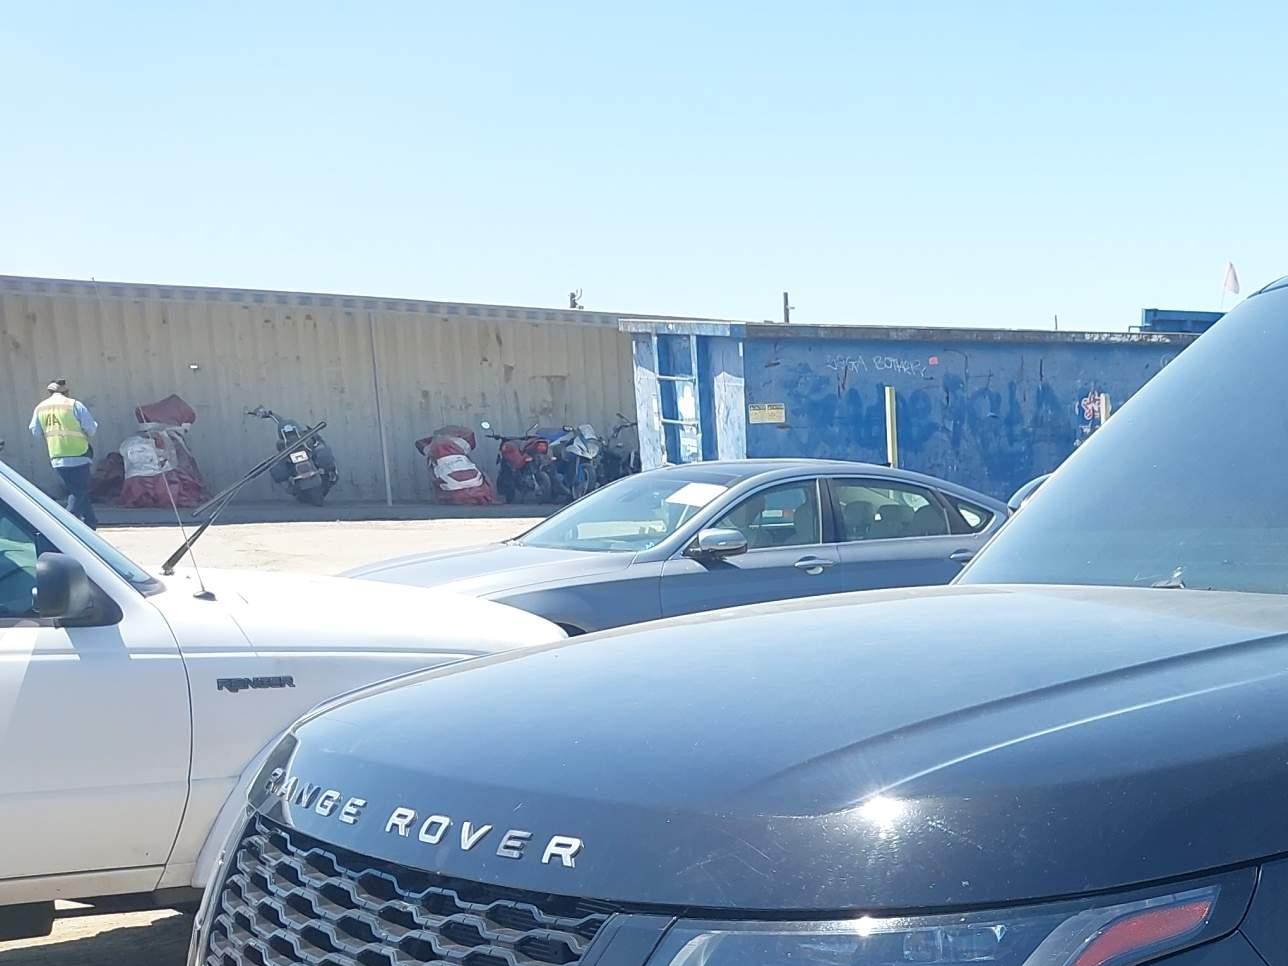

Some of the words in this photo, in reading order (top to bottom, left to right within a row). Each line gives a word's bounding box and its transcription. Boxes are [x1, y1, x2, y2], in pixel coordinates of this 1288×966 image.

[216, 675, 297, 693] RANGER
[265, 767, 367, 824] RANGE
[385, 806, 585, 868] ROVER
